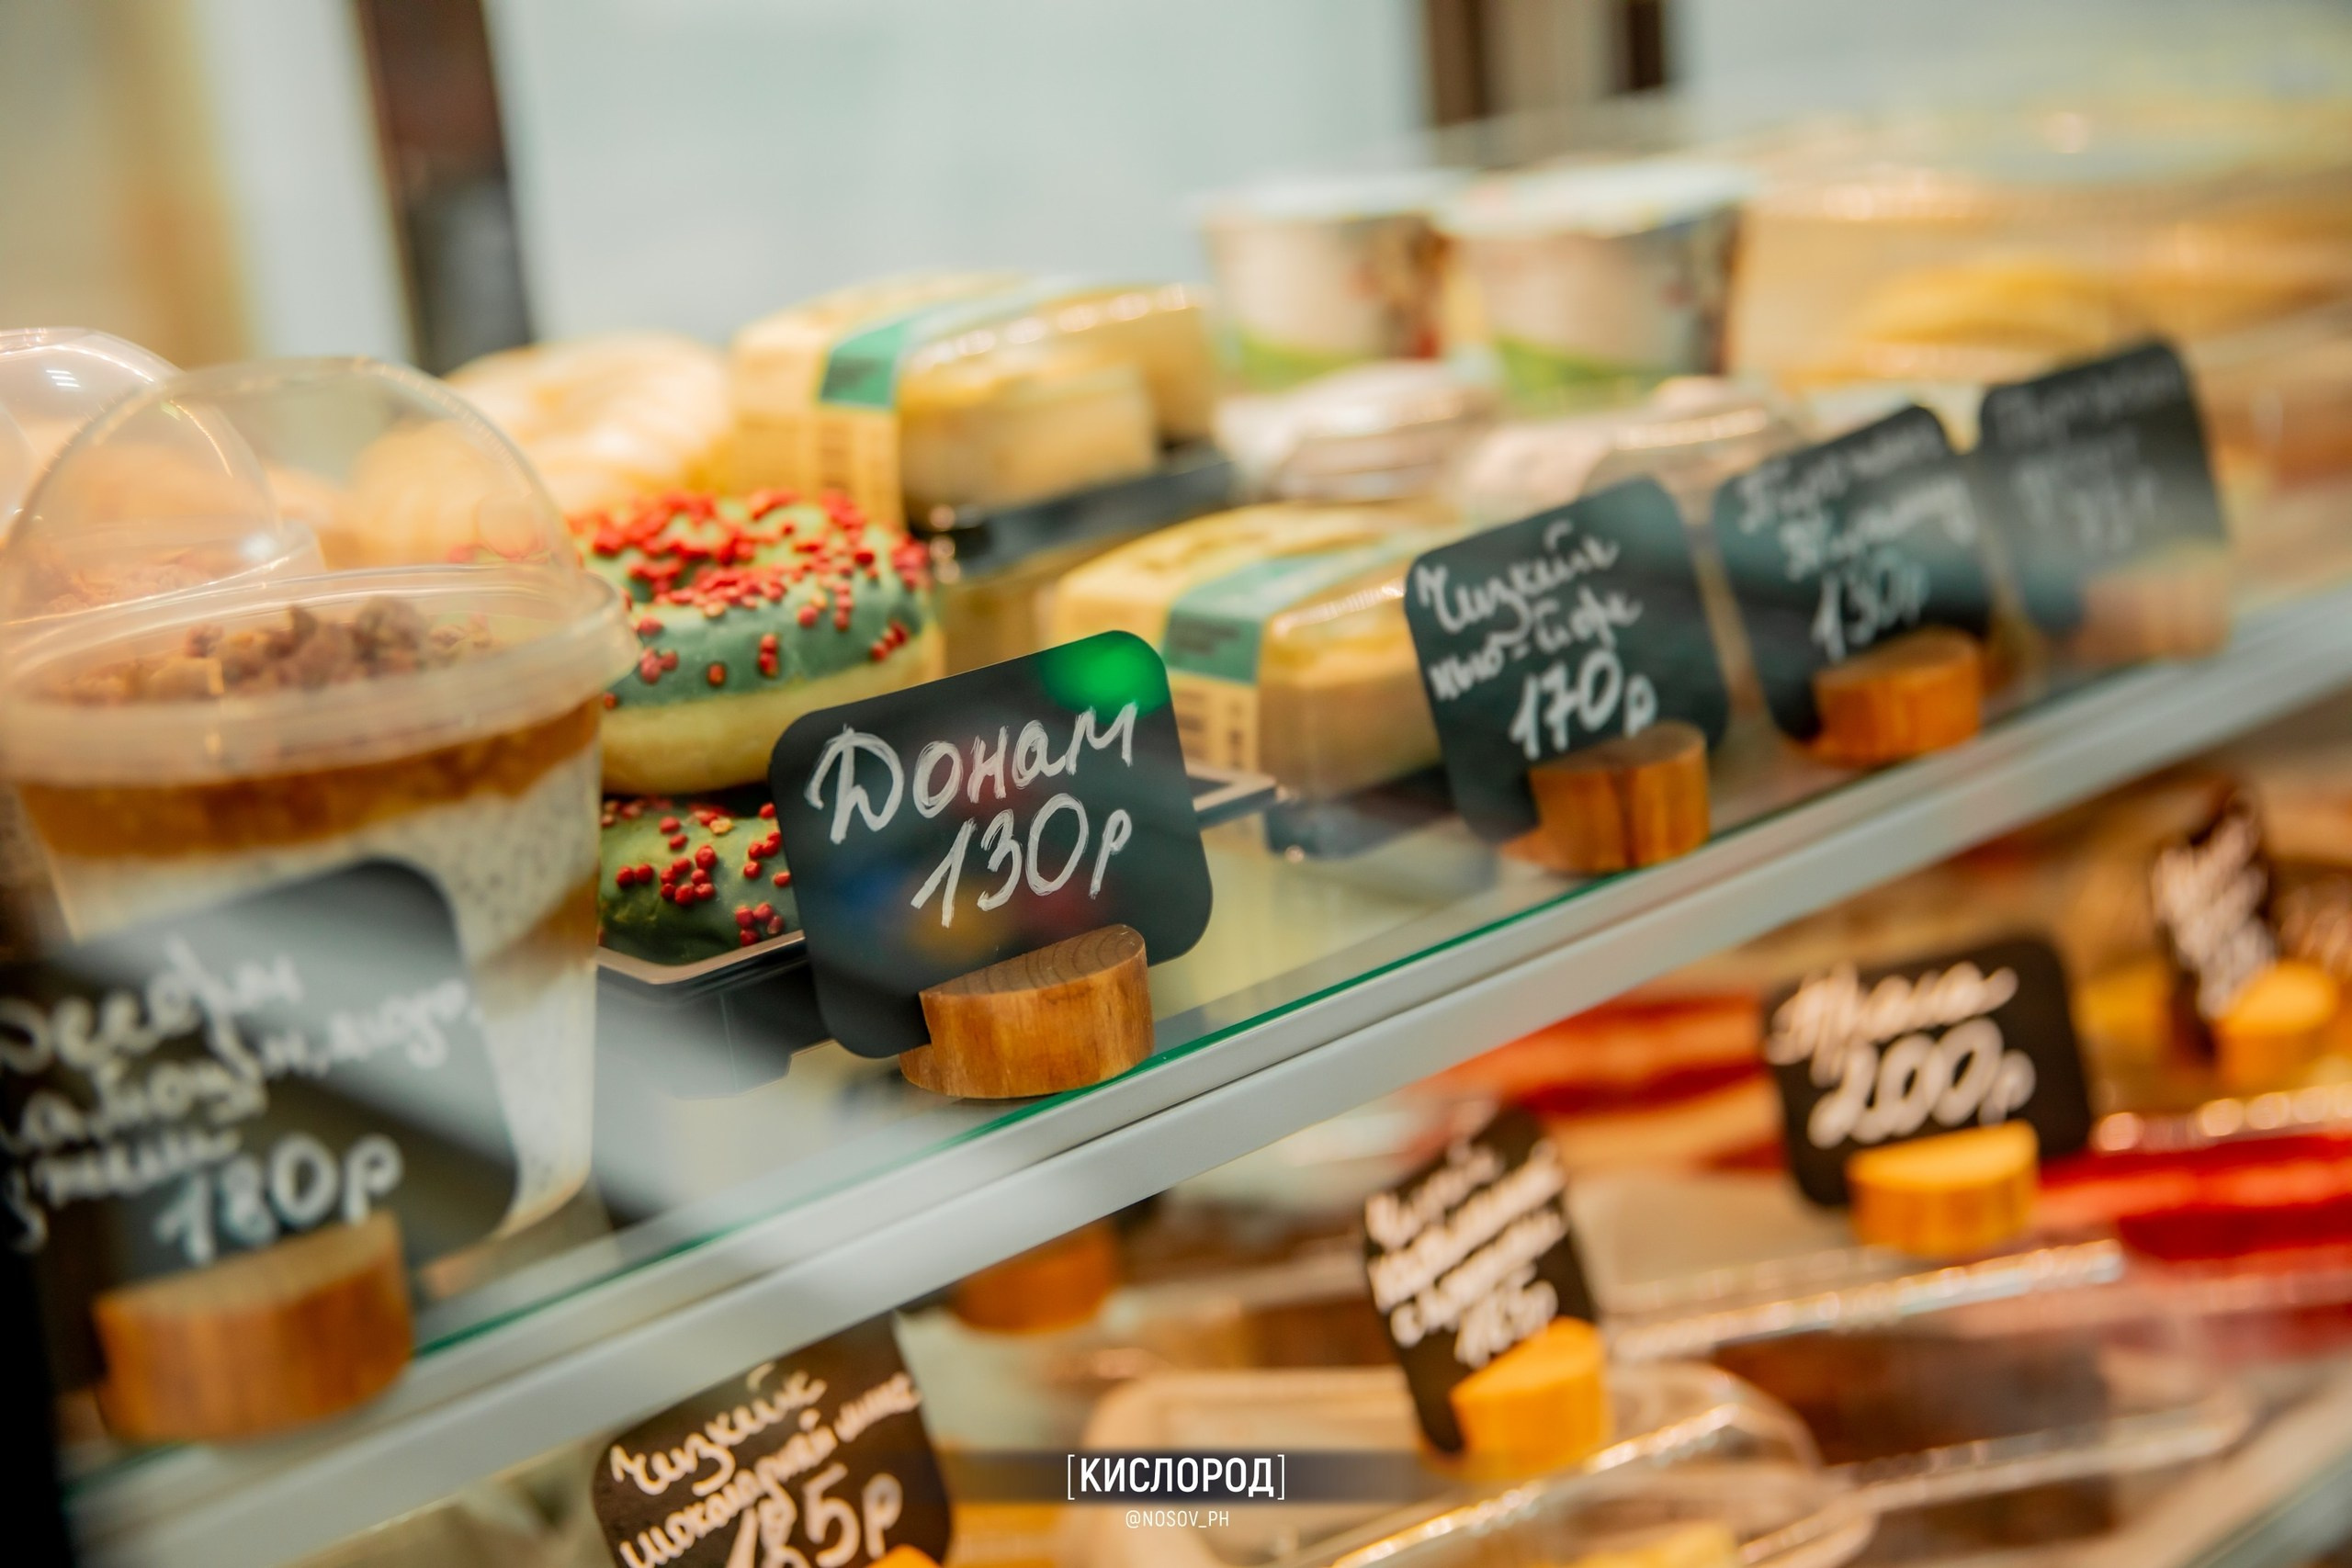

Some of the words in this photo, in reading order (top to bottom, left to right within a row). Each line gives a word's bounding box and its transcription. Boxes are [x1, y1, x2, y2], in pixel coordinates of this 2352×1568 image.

[1509, 647, 1658, 761] 170р
[910, 793, 1132, 928] 130р
[155, 1131, 403, 1266] 180р
[608, 1361, 827, 1497] Чизкейк
